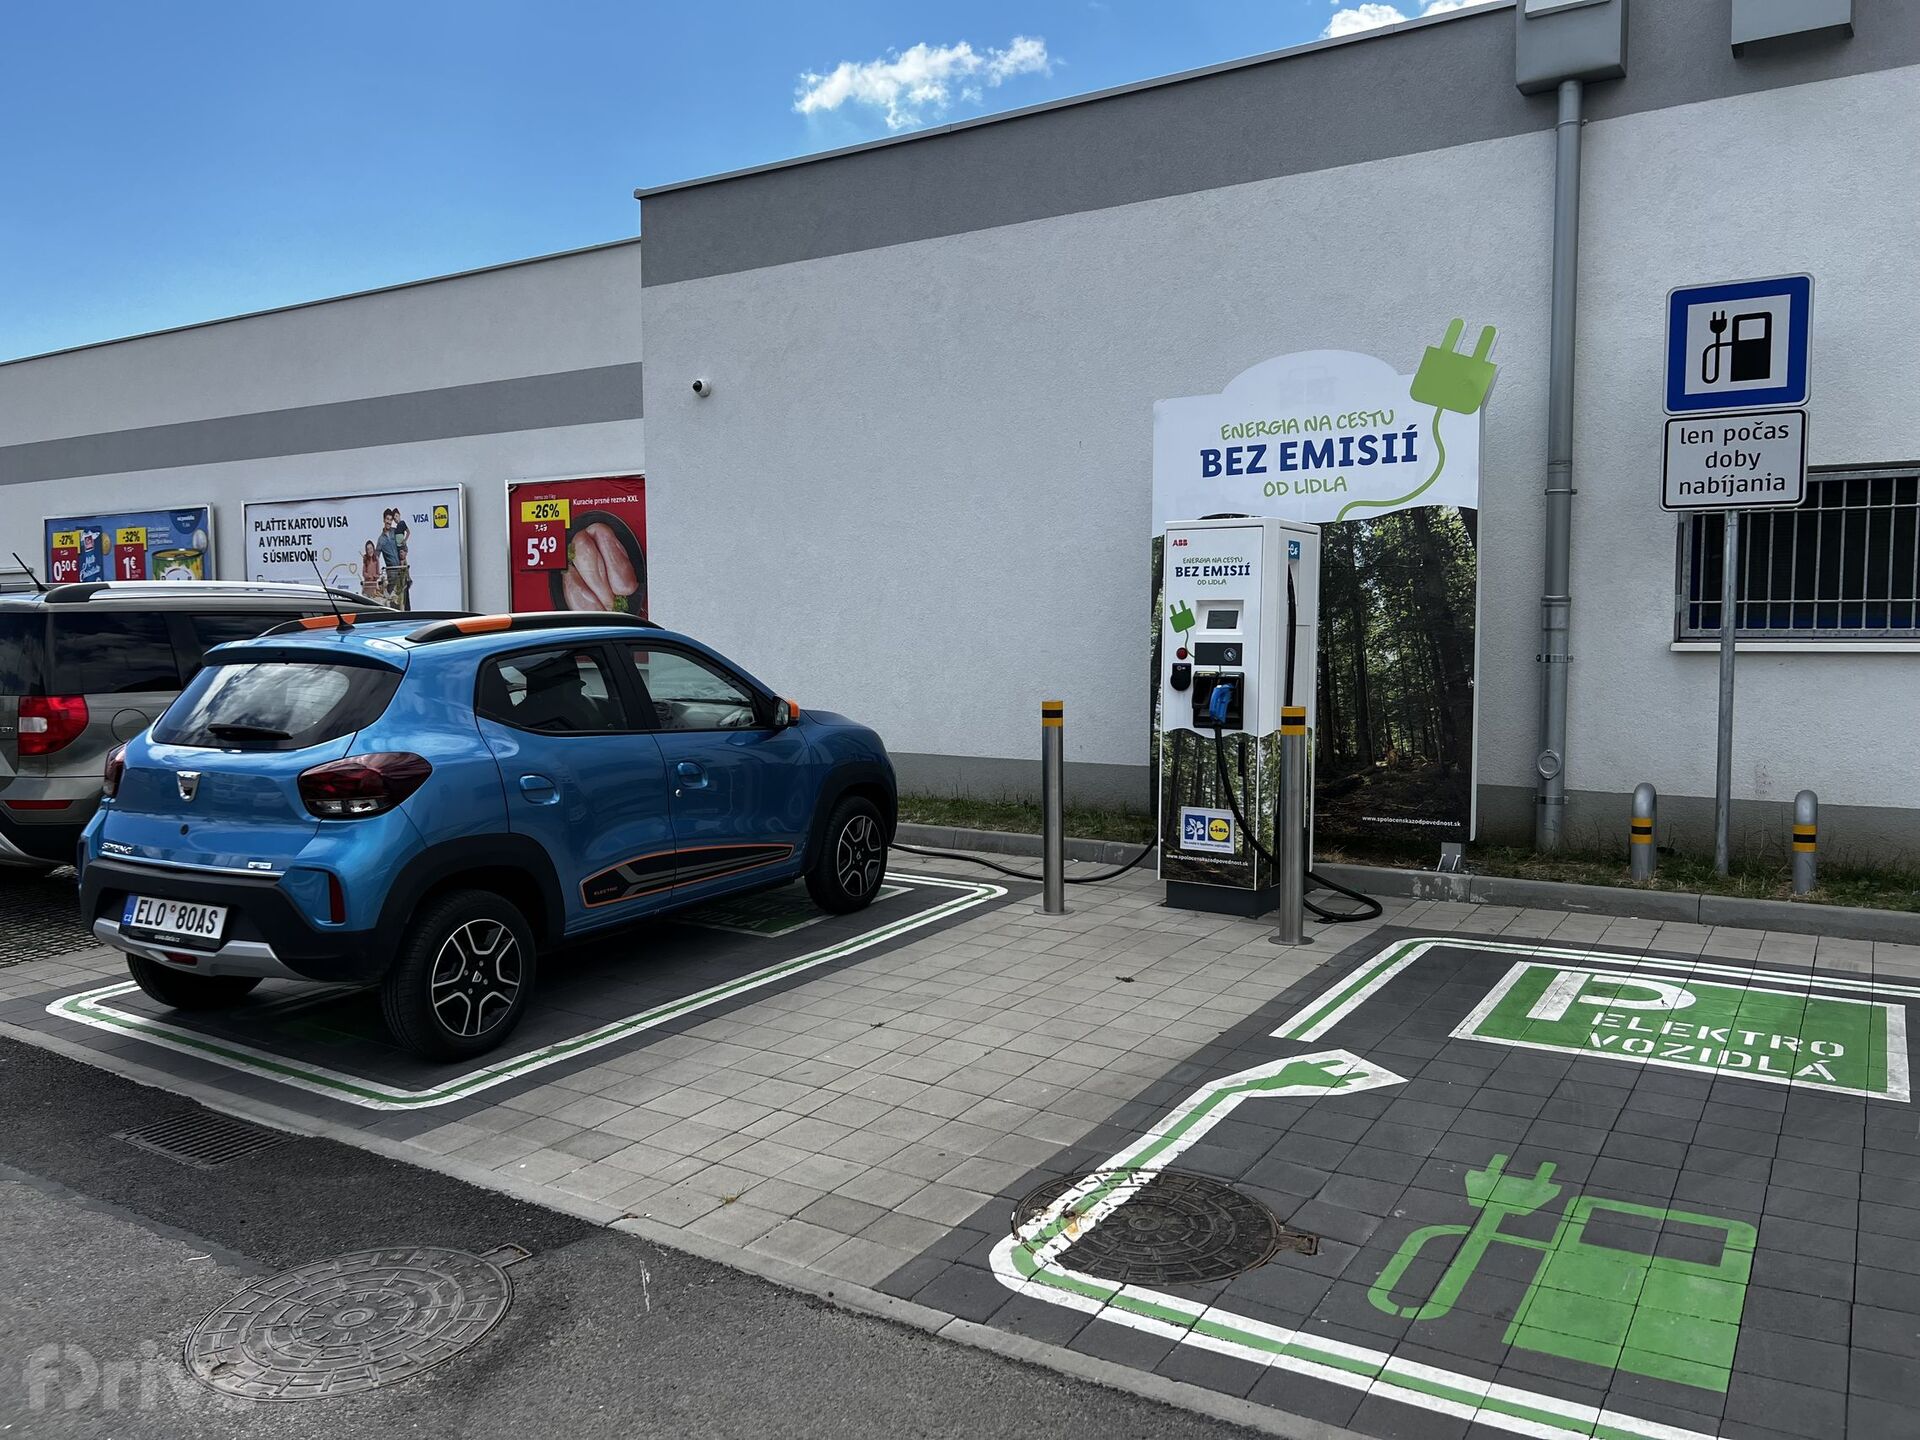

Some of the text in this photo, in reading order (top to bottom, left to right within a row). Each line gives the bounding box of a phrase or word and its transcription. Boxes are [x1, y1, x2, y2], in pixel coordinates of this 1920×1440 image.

[1221, 409, 1395, 441] ENERGIA NA CESTU
[1680, 421, 1789, 446] len počas
[1200, 424, 1418, 478] BEZ EMISIÍ
[1705, 450, 1761, 471] doby
[1263, 476, 1348, 497] OD LIDLA
[1679, 472, 1786, 497] nabíjania
[573, 497, 593, 506] Kuracie
[594, 498, 610, 506] prsné
[412, 513, 429, 523] VISA
[531, 503, 560, 518] -26%
[254, 515, 349, 532] PLAŤTE KARTOU VISA
[58, 535, 74, 546] -27%
[122, 530, 140, 543] -32%
[259, 534, 313, 548] A VYHRAJTE
[1172, 539, 1188, 547] ABB
[263, 549, 318, 563] S ÚSMEVOM!
[527, 537, 557, 566] 5.49
[1182, 557, 1211, 565] ENERGIA
[1222, 556, 1243, 564] CESTU
[1175, 562, 1251, 577] BEZ EMISIÍ
[1362, 815, 1461, 827] www.spolocenskazodpovednost.sk
[123, 913, 132, 922] CZ
[1526, 970, 1697, 1022] P
[1591, 1011, 1846, 1058] ELEKTRO
[1589, 1032, 1837, 1082] VOZIDLÁ
